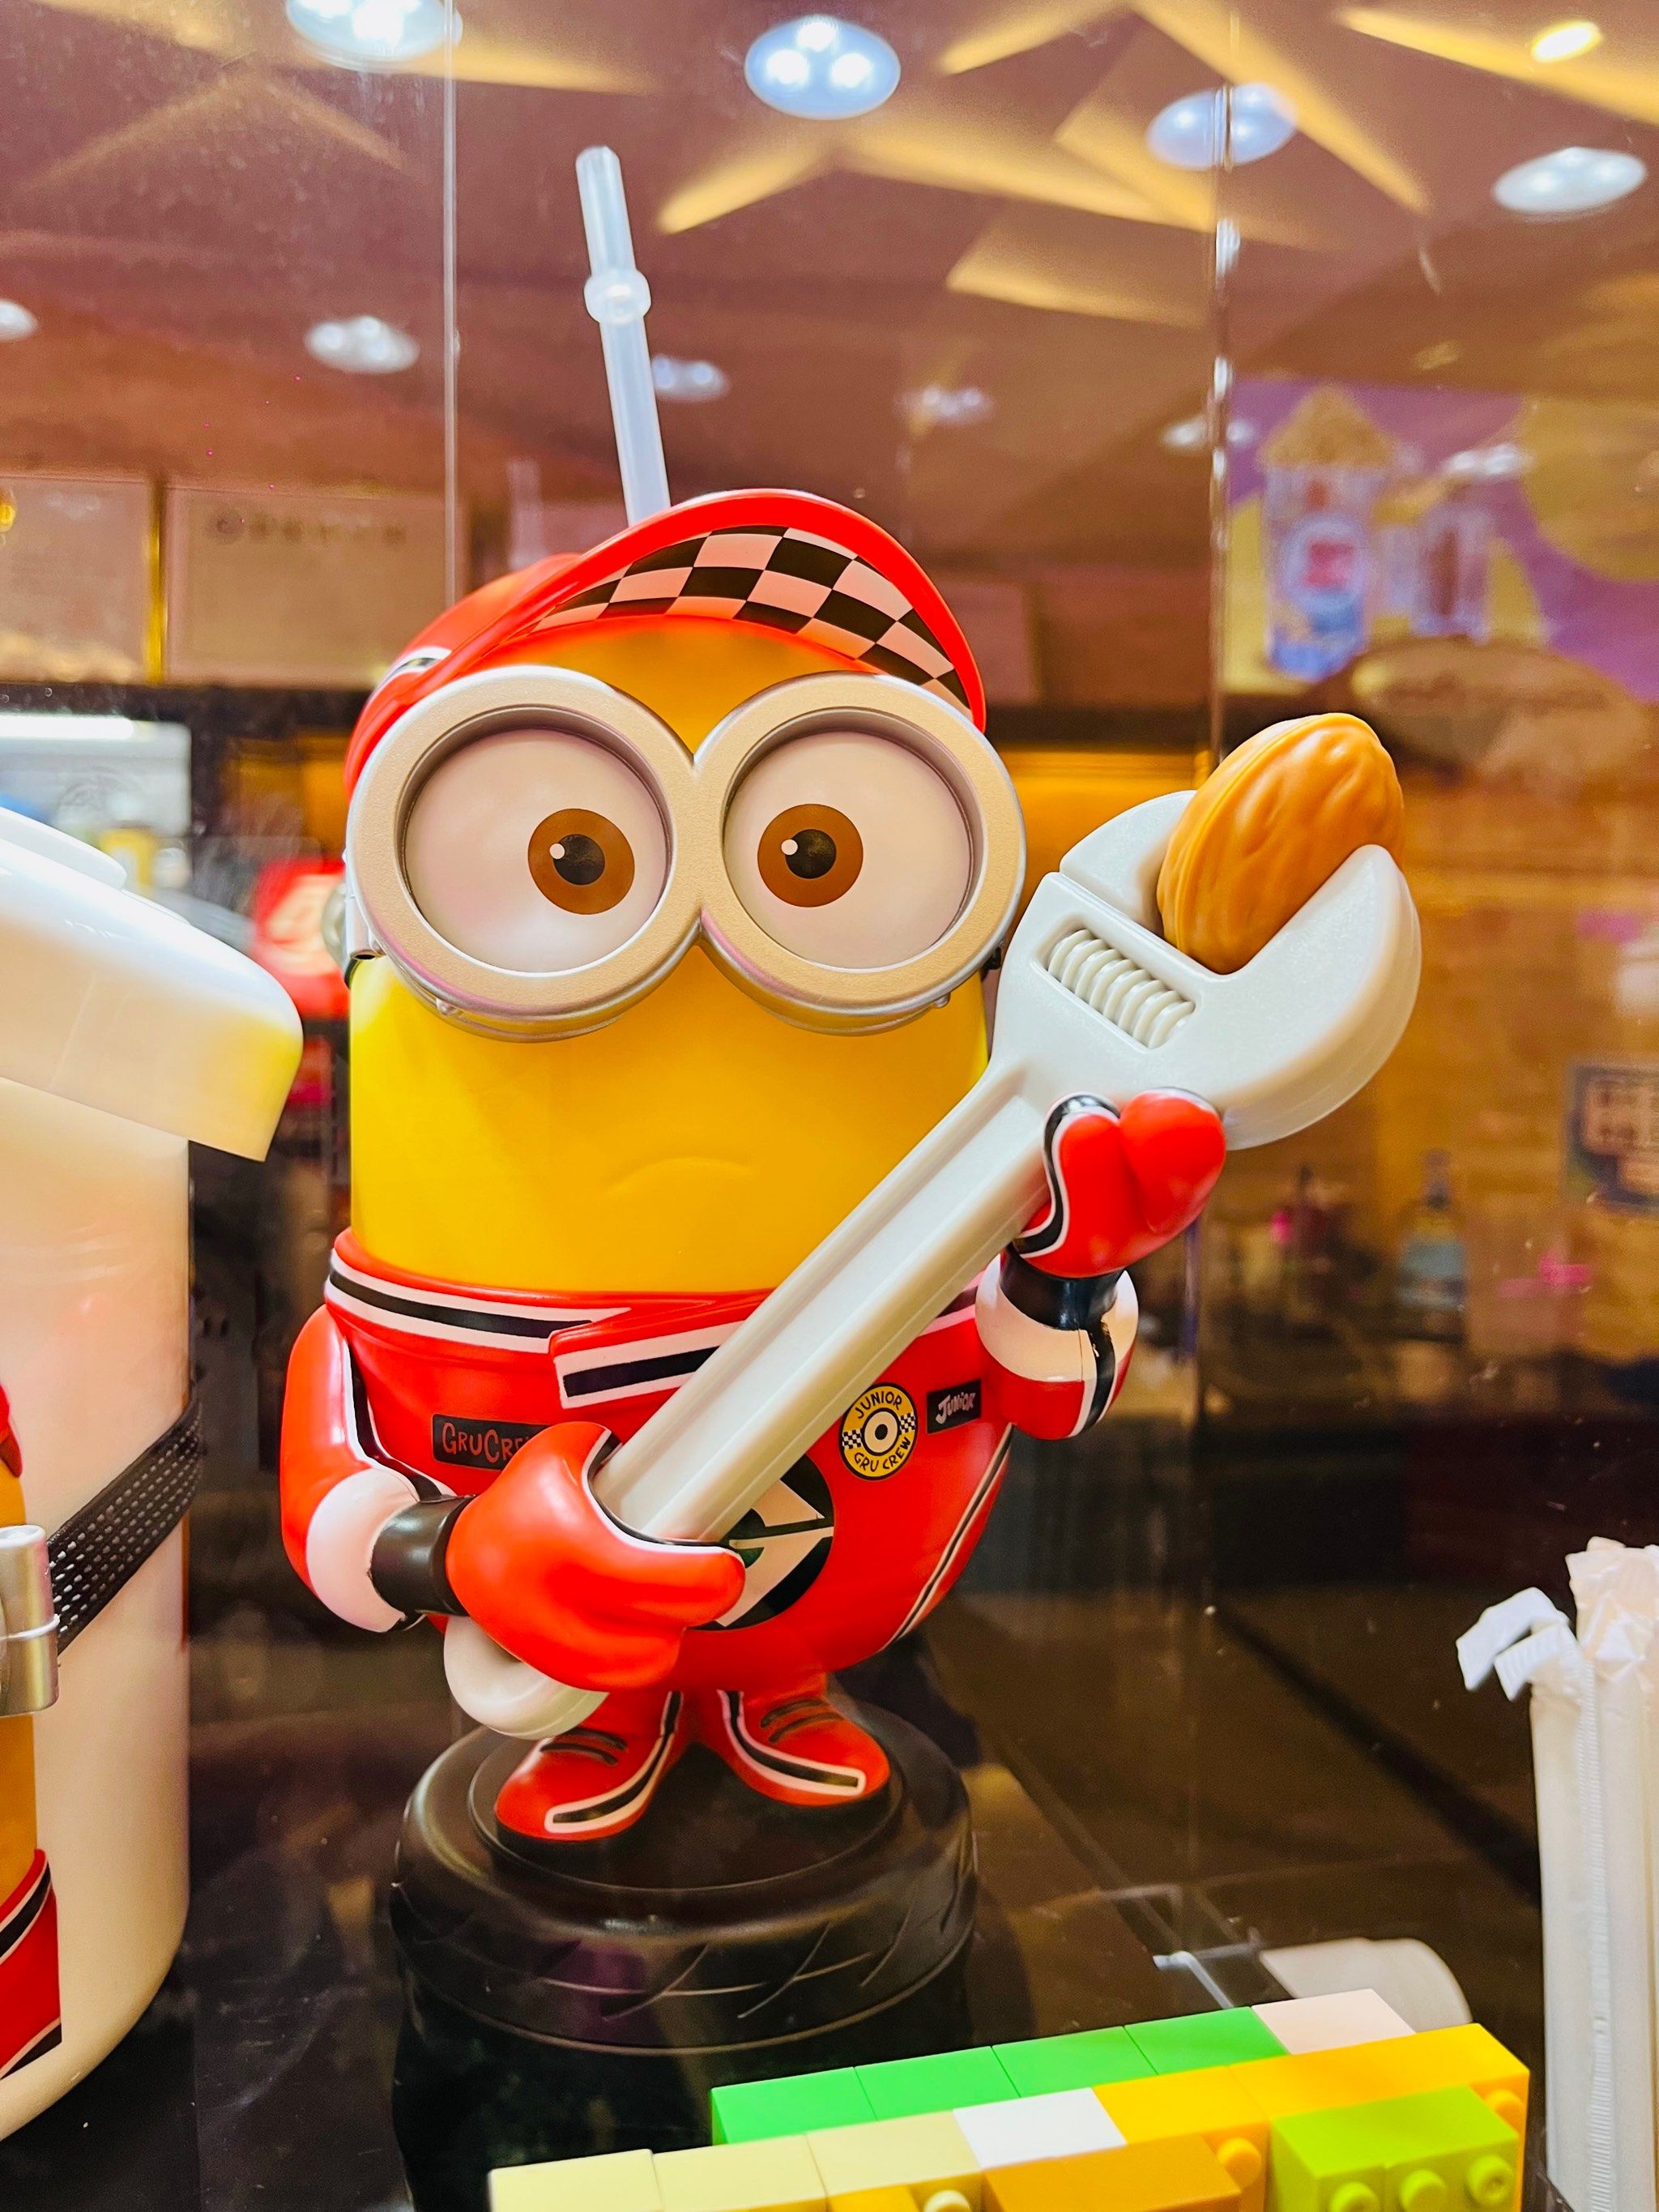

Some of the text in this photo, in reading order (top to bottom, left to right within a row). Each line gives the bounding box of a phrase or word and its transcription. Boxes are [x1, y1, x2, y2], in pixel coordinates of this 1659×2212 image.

[855, 1390, 902, 1419] JUNIOR
[854, 1437, 911, 1472] GRU CREW
